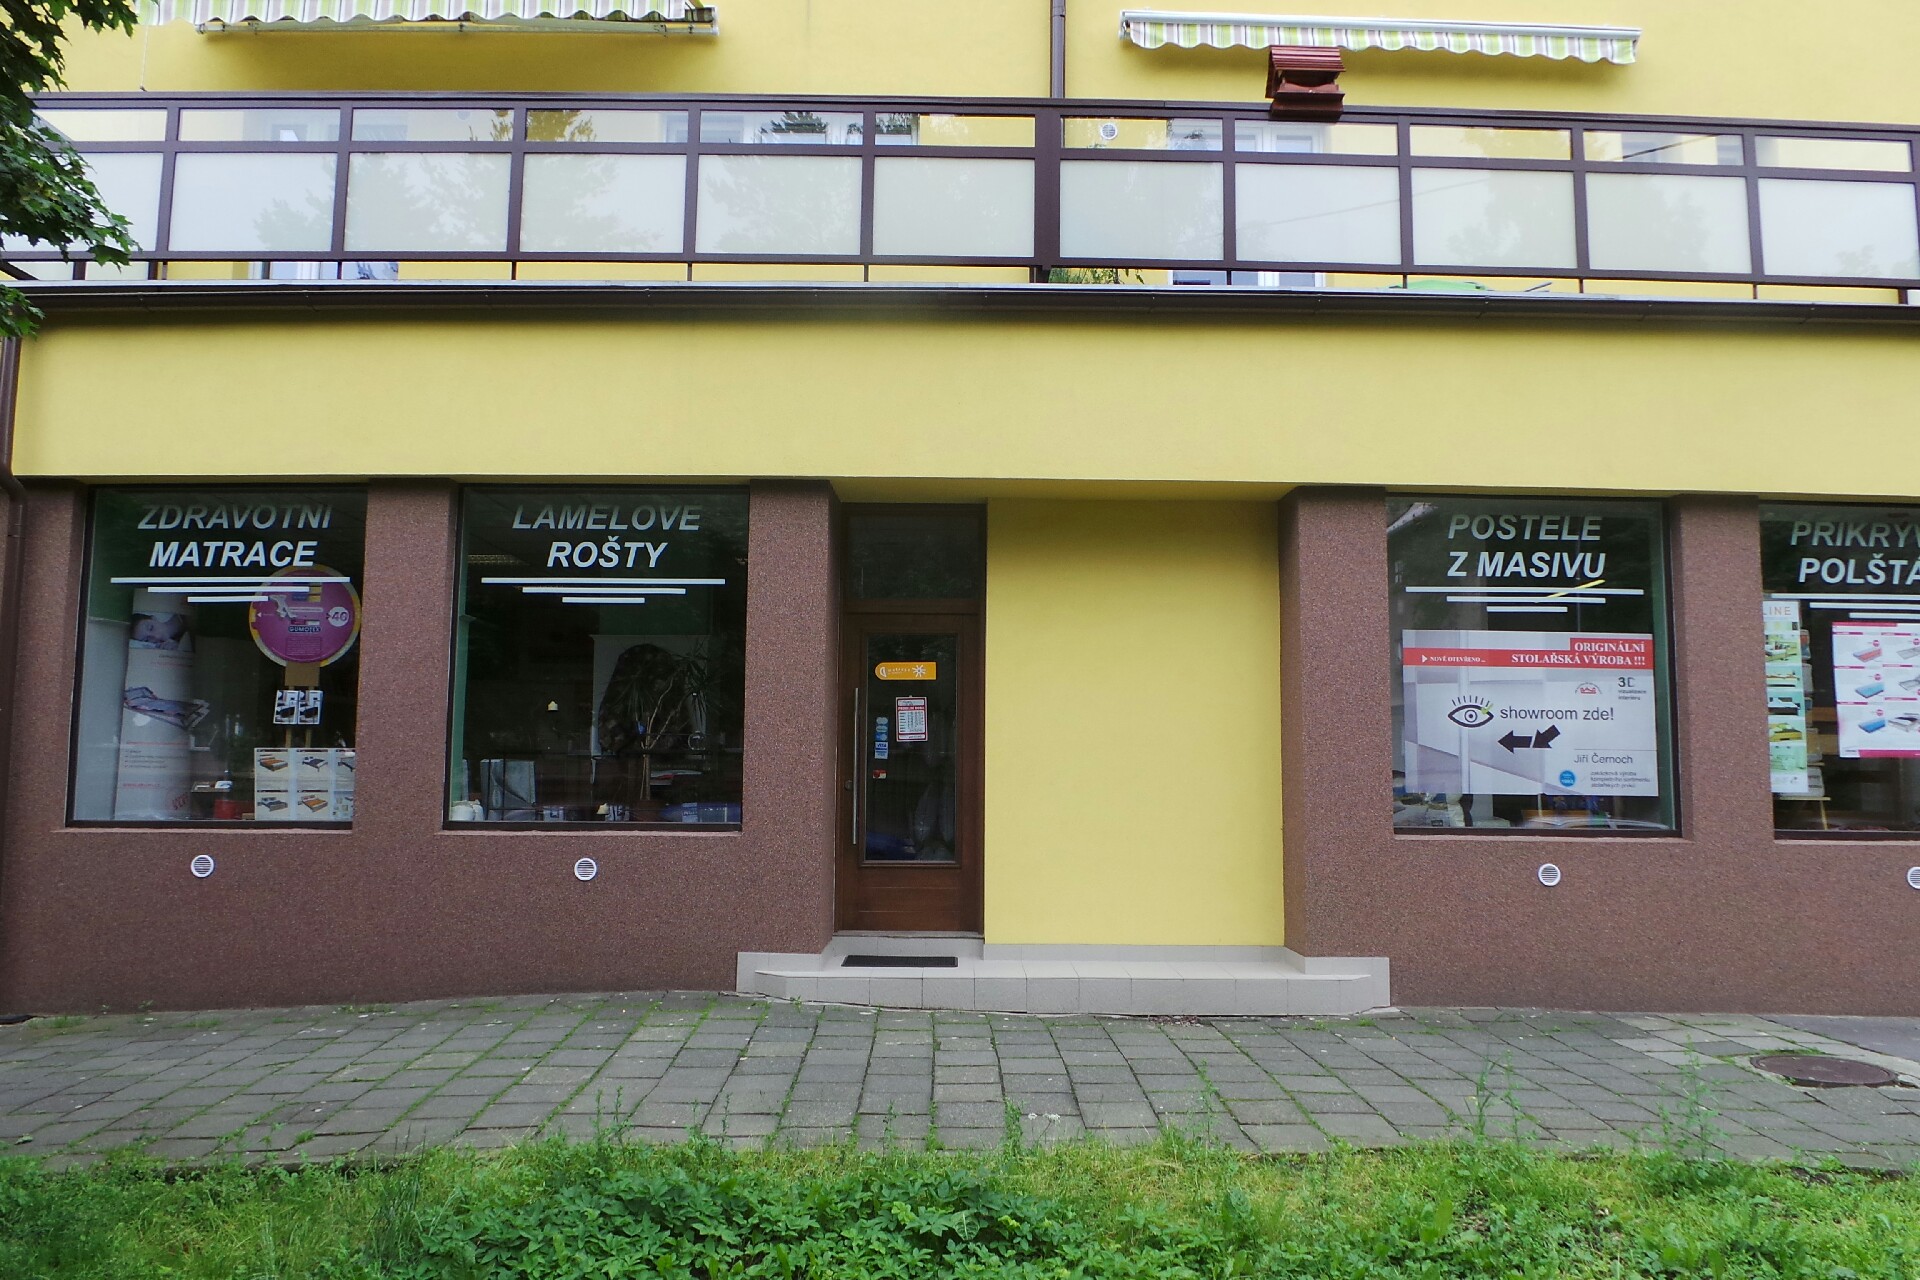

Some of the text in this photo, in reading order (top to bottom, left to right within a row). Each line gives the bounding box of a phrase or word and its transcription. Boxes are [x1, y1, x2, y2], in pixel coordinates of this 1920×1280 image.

[1447, 513, 1603, 541] POSTELE
[149, 540, 319, 568] MATRACE
[546, 535, 669, 568] ROŠTY
[1447, 551, 1607, 578] Z MASIVU
[1574, 641, 1646, 653] ORIGINÁLNÍ
[1511, 652, 1581, 664] STOLAŘSKÁ
[1583, 653, 1632, 665] VÝROBA
[1500, 706, 1614, 720] showroom zde!
[1574, 752, 1633, 764] Jiří Černoch
